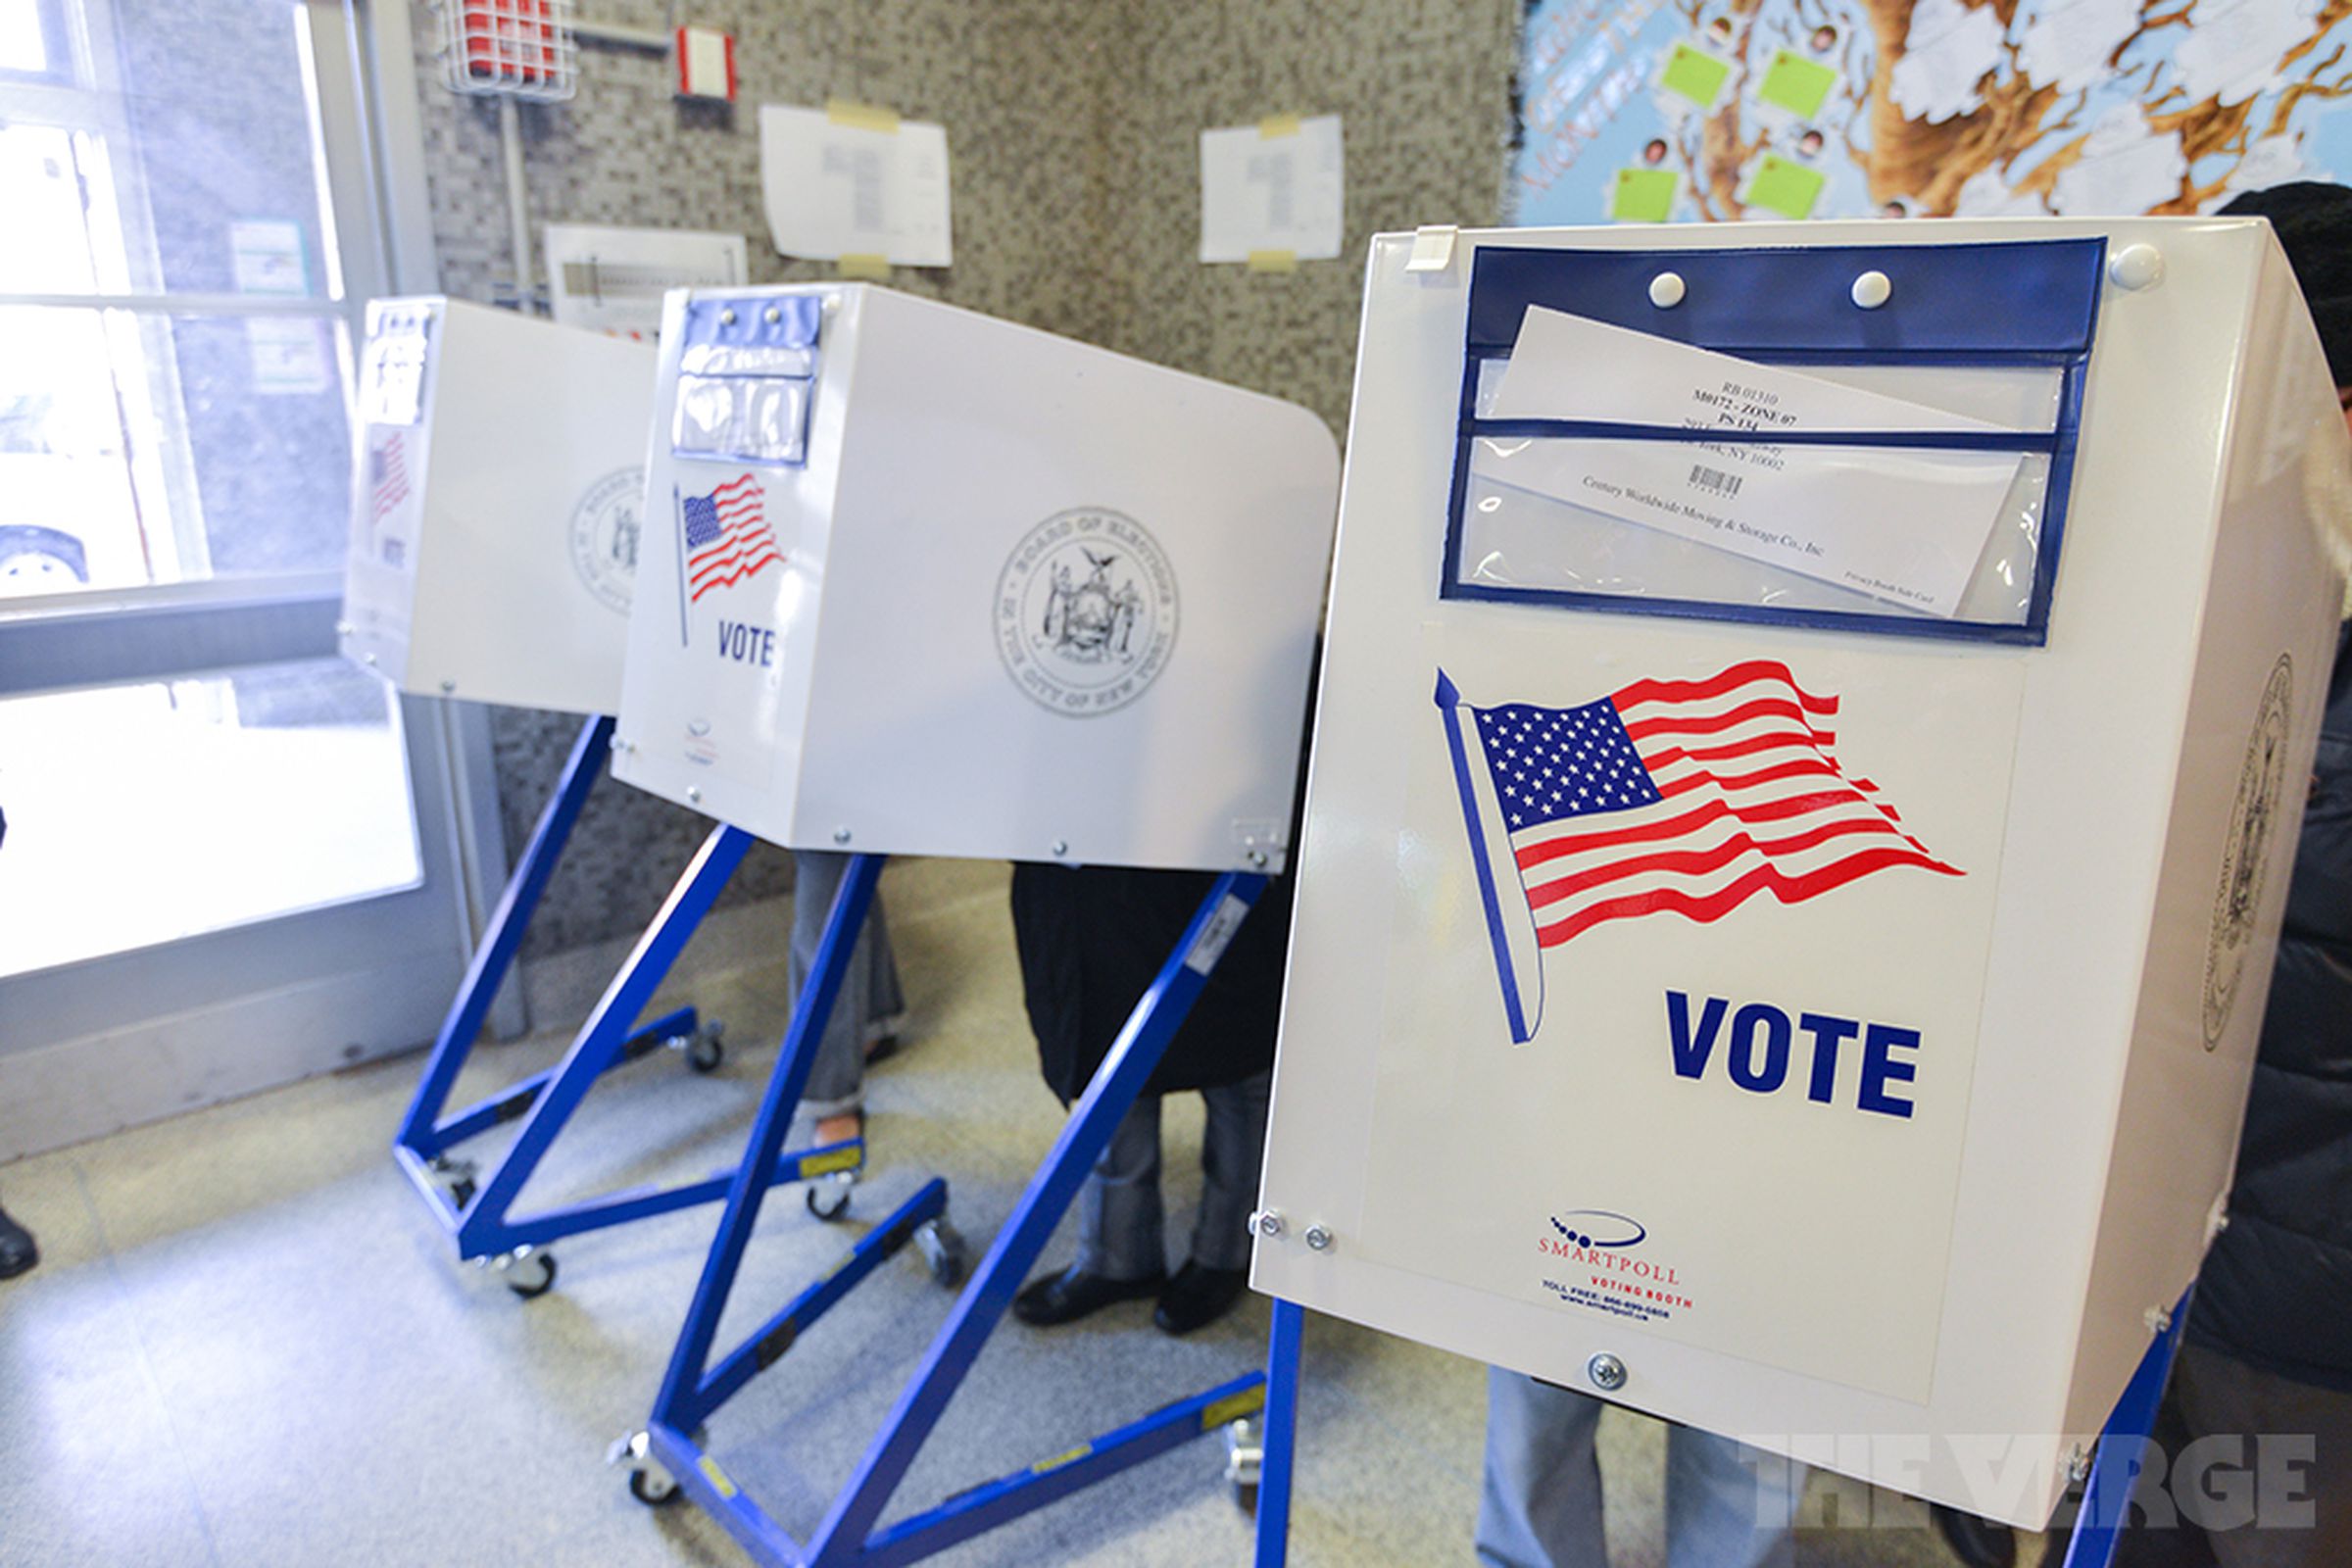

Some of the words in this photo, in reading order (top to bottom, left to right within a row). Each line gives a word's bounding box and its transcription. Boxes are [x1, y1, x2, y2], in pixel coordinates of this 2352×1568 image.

[1693, 389, 1733, 410] M0172
[1741, 403, 1780, 421] ZONE
[1781, 413, 1797, 426] 07
[1723, 382, 1741, 397] RB
[1718, 412, 1735, 425] PS
[1731, 447, 1746, 460] NY
[1583, 475, 1622, 498] Century
[1626, 488, 1681, 514] Worldwide
[1683, 505, 1723, 529] Moving
[1725, 519, 1736, 531] &
[1739, 522, 1779, 544] Storage
[1015, 520, 1072, 575] BOARD
[1077, 515, 1103, 533] OF
[1106, 519, 1172, 606] ELECTIONS
[718, 619, 775, 667] VOTE
[1022, 667, 1064, 704] CITY
[1064, 689, 1090, 709] OF
[1666, 990, 1921, 1118] VOTE
[1538, 1238, 1680, 1286] SMARTPOLL
[1542, 1279, 1568, 1294] TOLL
[1591, 1276, 1642, 1298] VOTING
[1645, 1289, 1693, 1309] BOOTH
